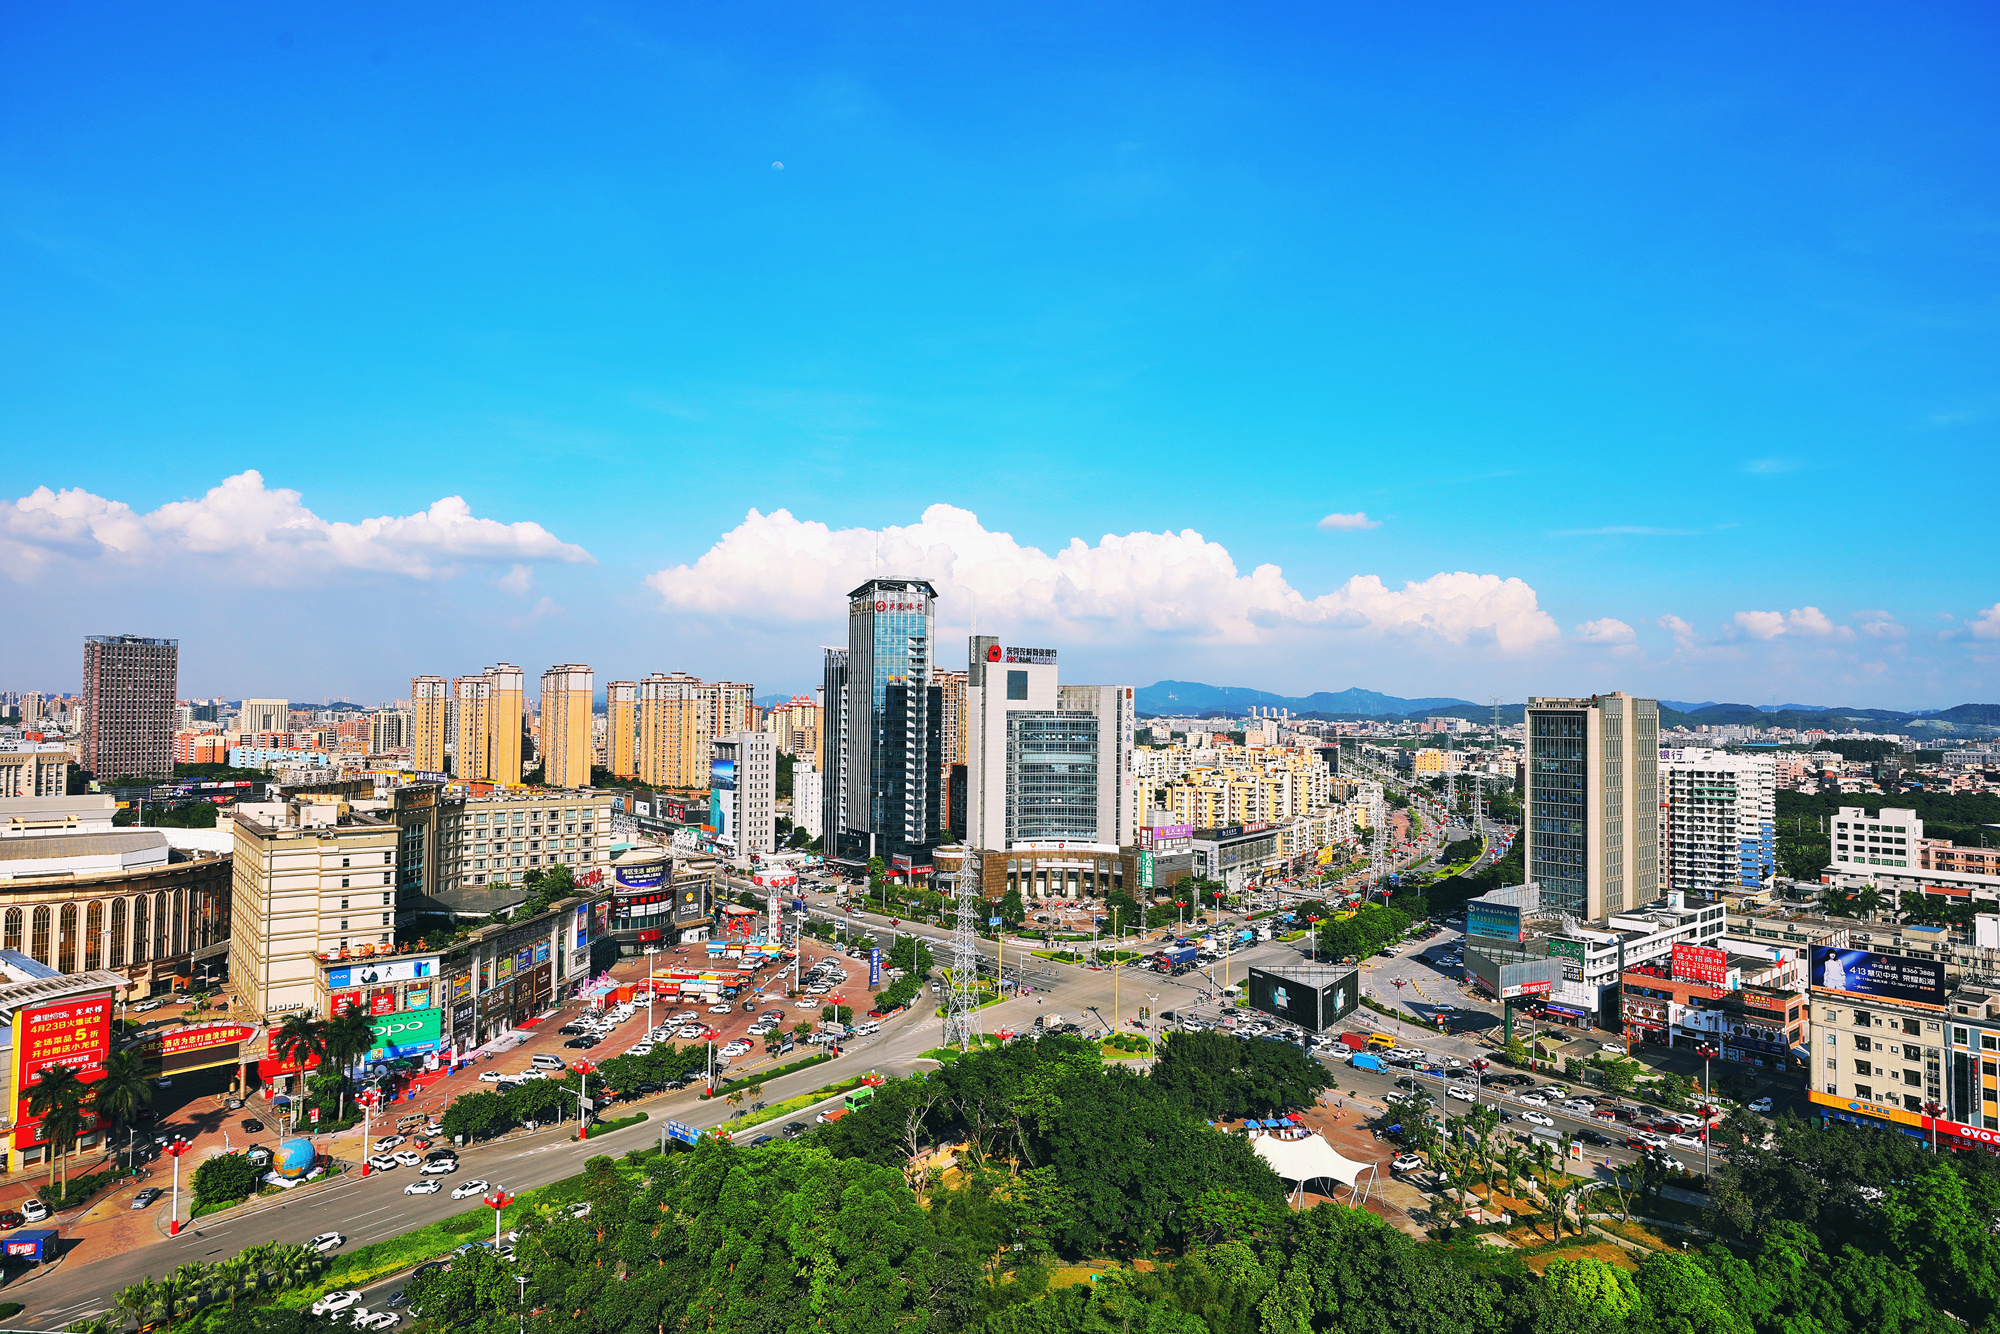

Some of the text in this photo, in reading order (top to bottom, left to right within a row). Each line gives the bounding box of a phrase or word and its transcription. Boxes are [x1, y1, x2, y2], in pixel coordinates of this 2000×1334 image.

[890, 602, 924, 611] 东莞银行
[1659, 750, 1683, 760] 银行
[1676, 953, 1722, 965] 盛大招商中
[30, 1016, 101, 1034] 4月23日火爆试业
[32, 1040, 99, 1058] 开台即送小龙虾
[1960, 1127, 1991, 1140] OYO
